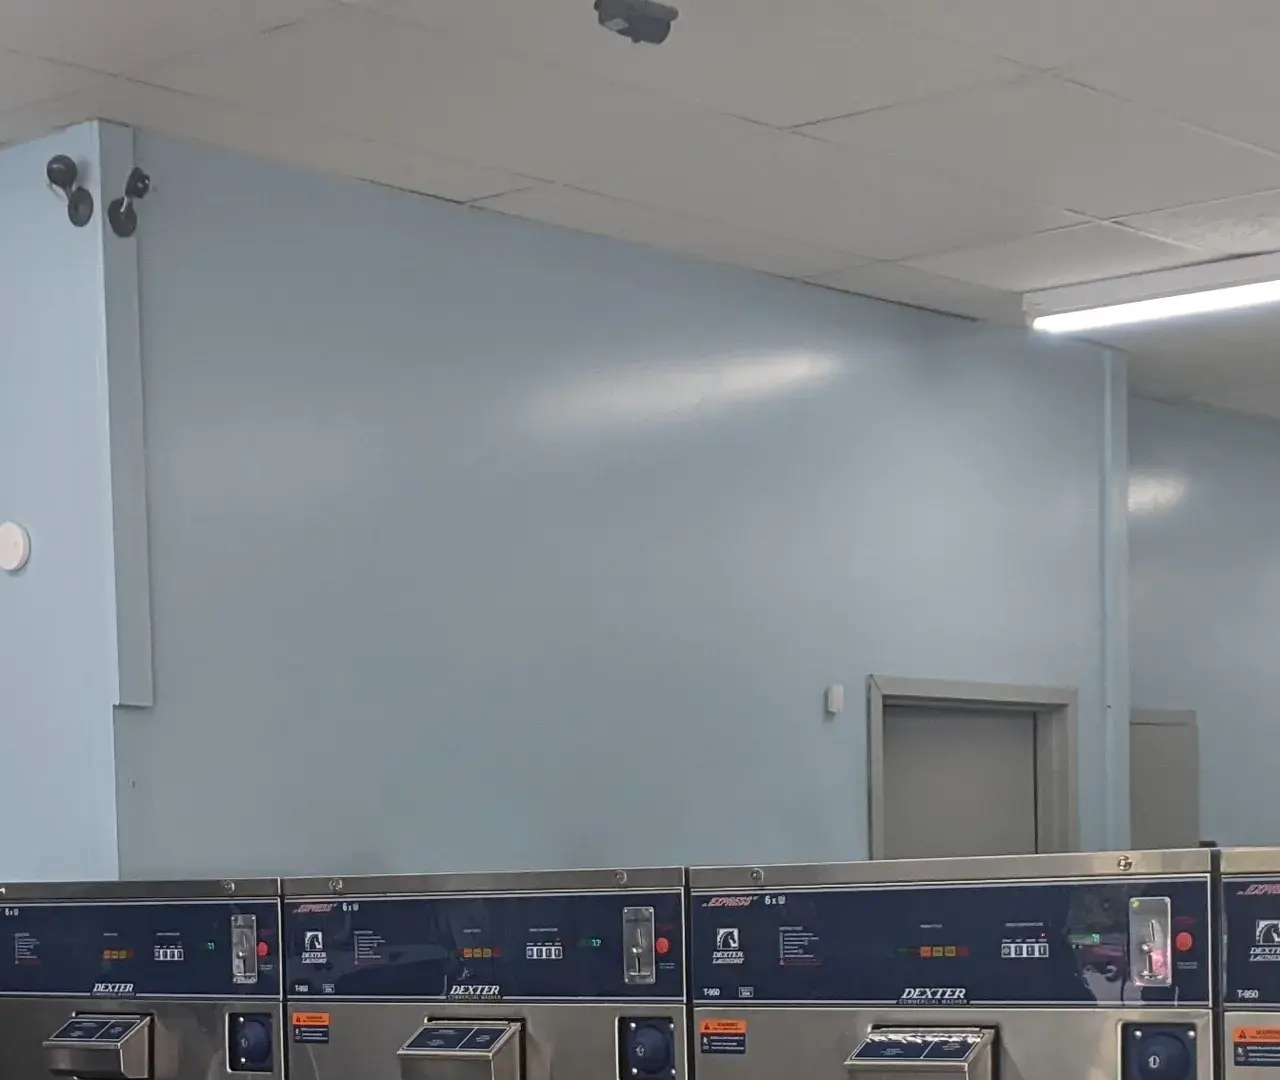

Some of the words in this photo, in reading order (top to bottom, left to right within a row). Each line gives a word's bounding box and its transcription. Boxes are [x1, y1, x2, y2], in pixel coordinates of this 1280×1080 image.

[764, 895, 771, 905] 6
[342, 902, 348, 911] 6
[92, 983, 135, 993] DEXTER
[449, 985, 501, 995] DEXTER
[900, 988, 967, 999] DEXTER
